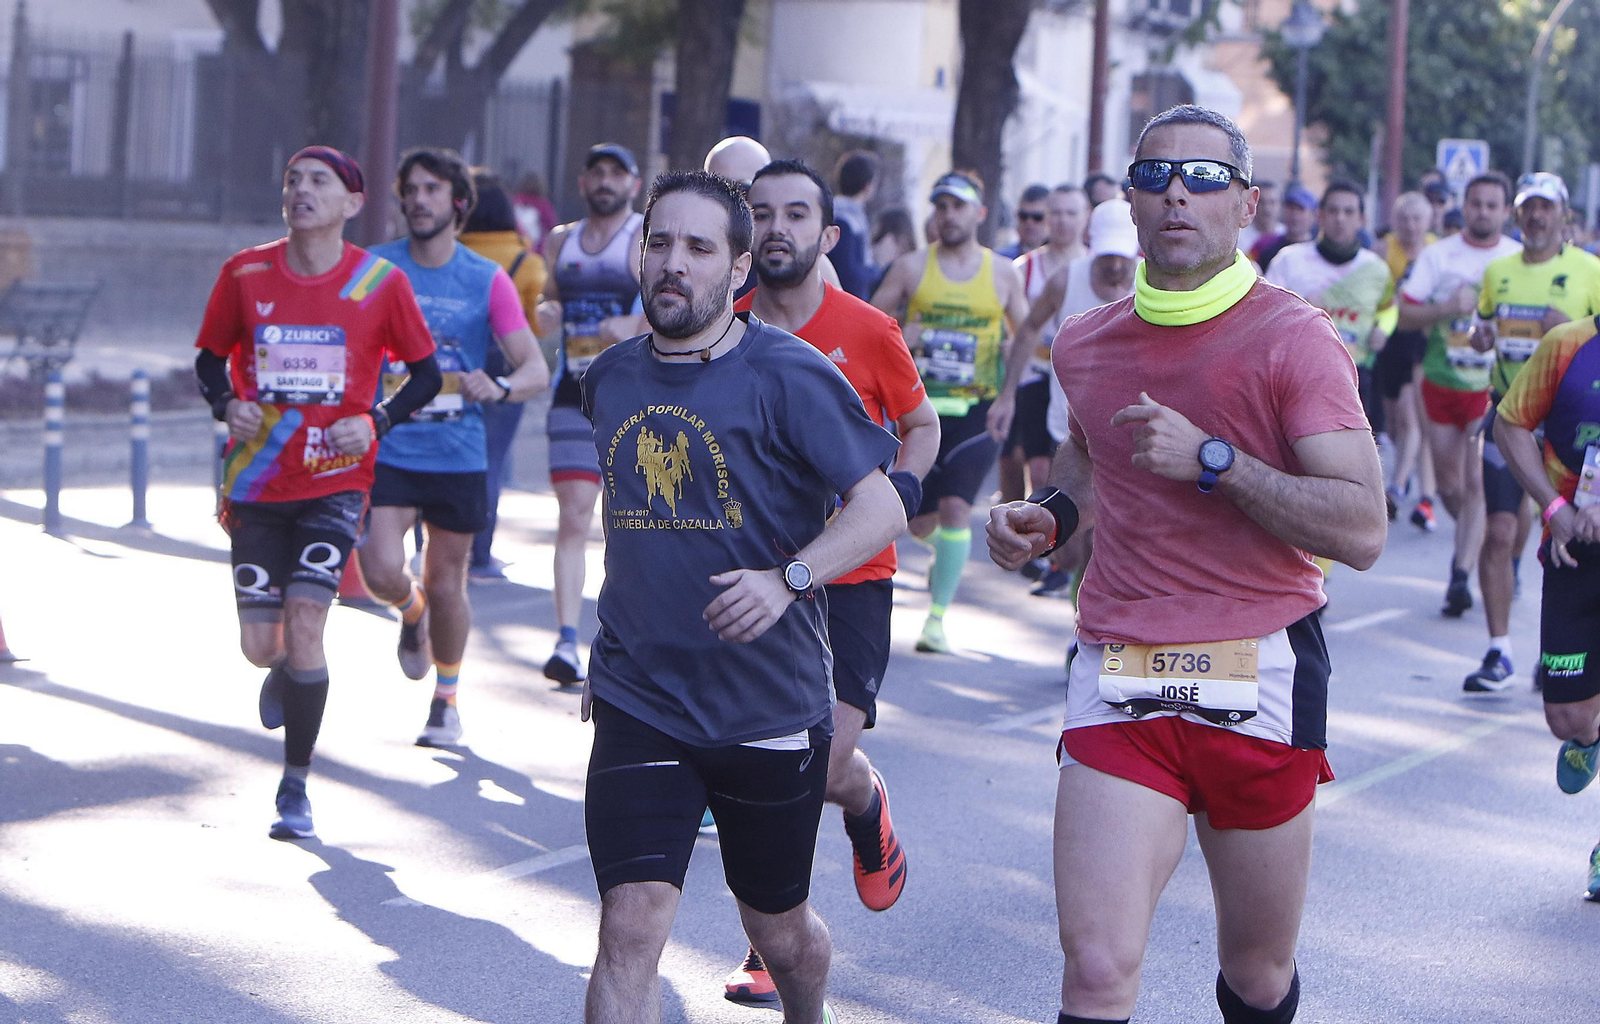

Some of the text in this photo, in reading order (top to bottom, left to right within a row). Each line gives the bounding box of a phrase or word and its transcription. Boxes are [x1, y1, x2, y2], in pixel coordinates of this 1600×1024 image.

[283, 357, 318, 370] 6336
[276, 376, 323, 387] SANTIAGO
[606, 410, 646, 467] CARRERA
[647, 405, 706, 432] POPULAR
[701, 430, 729, 499] MORISCA
[635, 509, 650, 517] 2017
[620, 519, 656, 530] PUEBLA
[657, 519, 672, 530] DE
[672, 519, 725, 530] CAZALLA
[1151, 652, 1211, 674] 5736
[1156, 682, 1200, 702] JOSÉ
